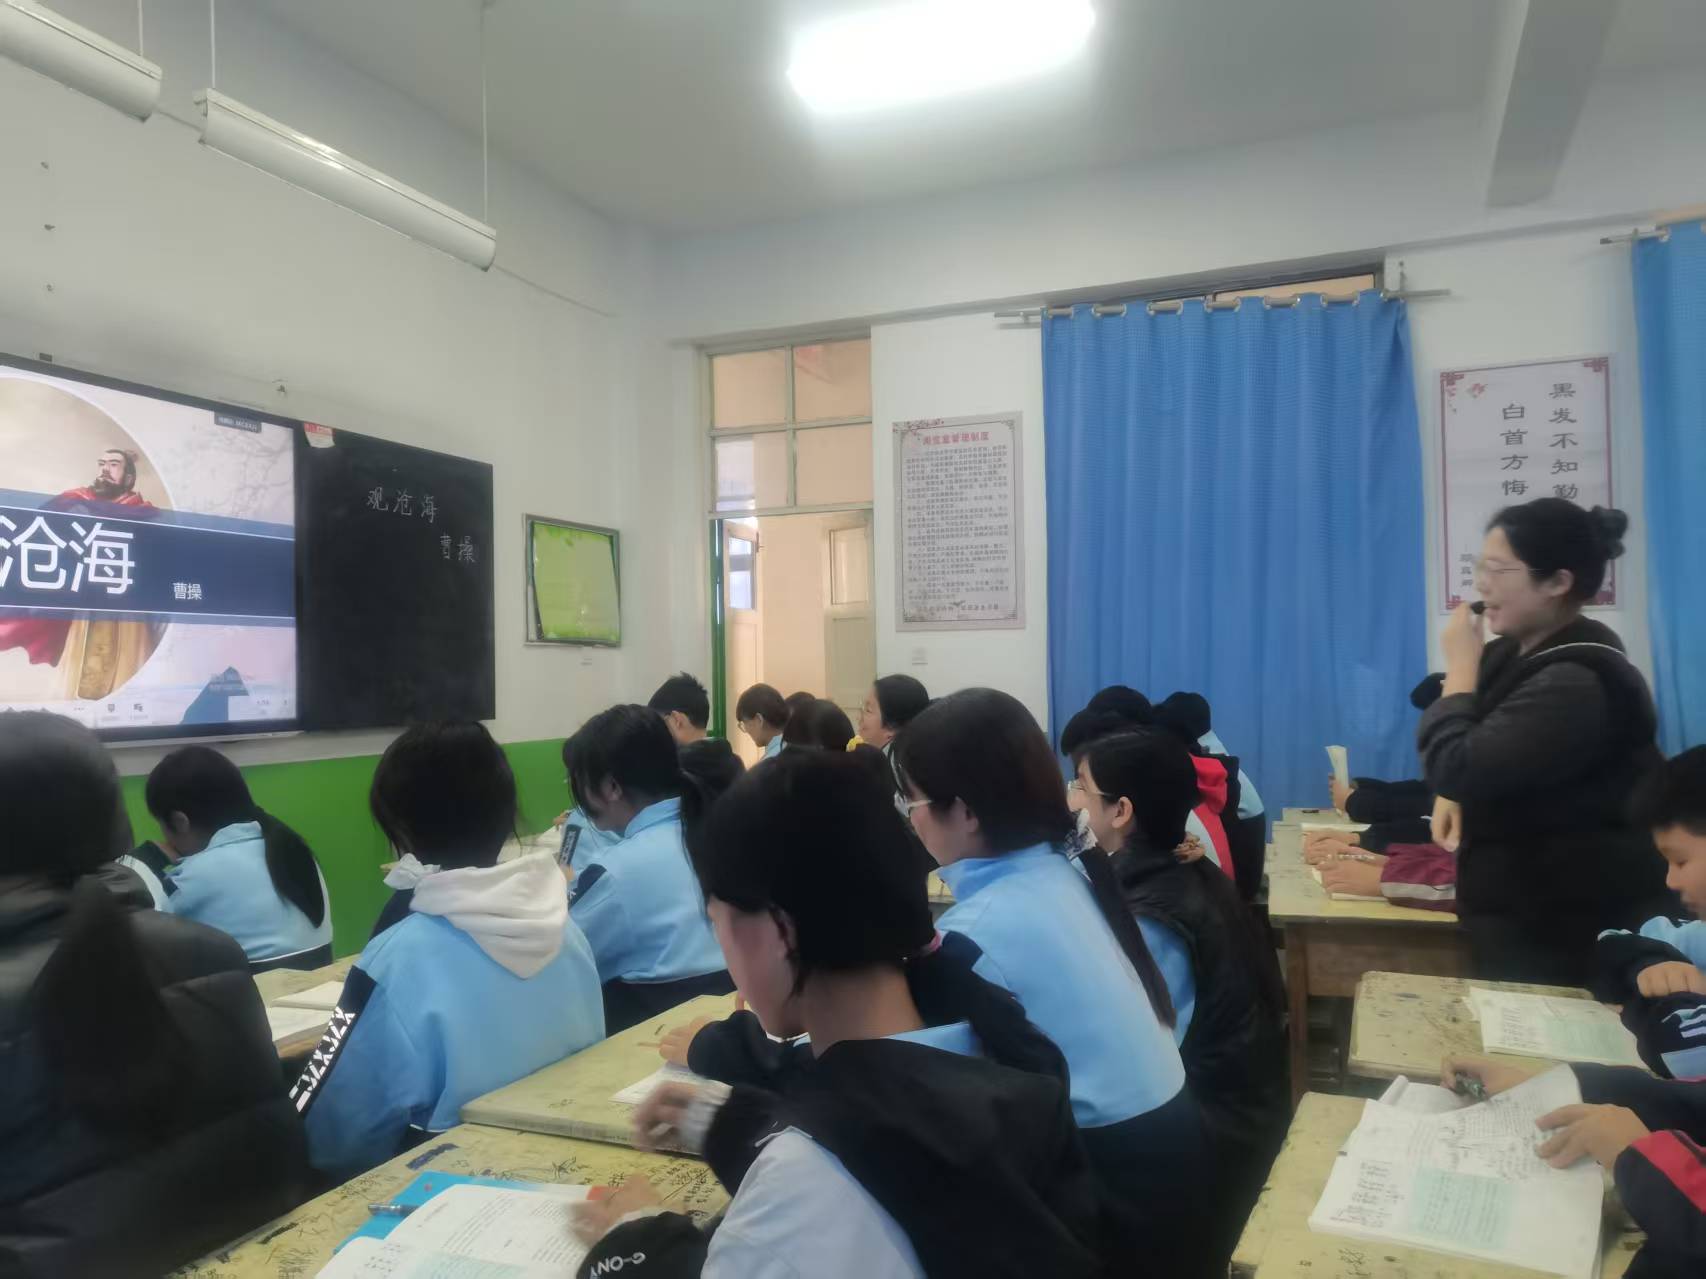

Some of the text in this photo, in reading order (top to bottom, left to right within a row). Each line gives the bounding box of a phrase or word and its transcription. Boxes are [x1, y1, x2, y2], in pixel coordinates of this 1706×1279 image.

[1500, 403, 1529, 496] 白首方悔
[1549, 382, 1579, 499] 黑发不知勤
[366, 486, 437, 524] 观沧海
[0, 514, 136, 595] 沧海
[440, 533, 476, 562] 曹操
[172, 582, 202, 600] 曹操
